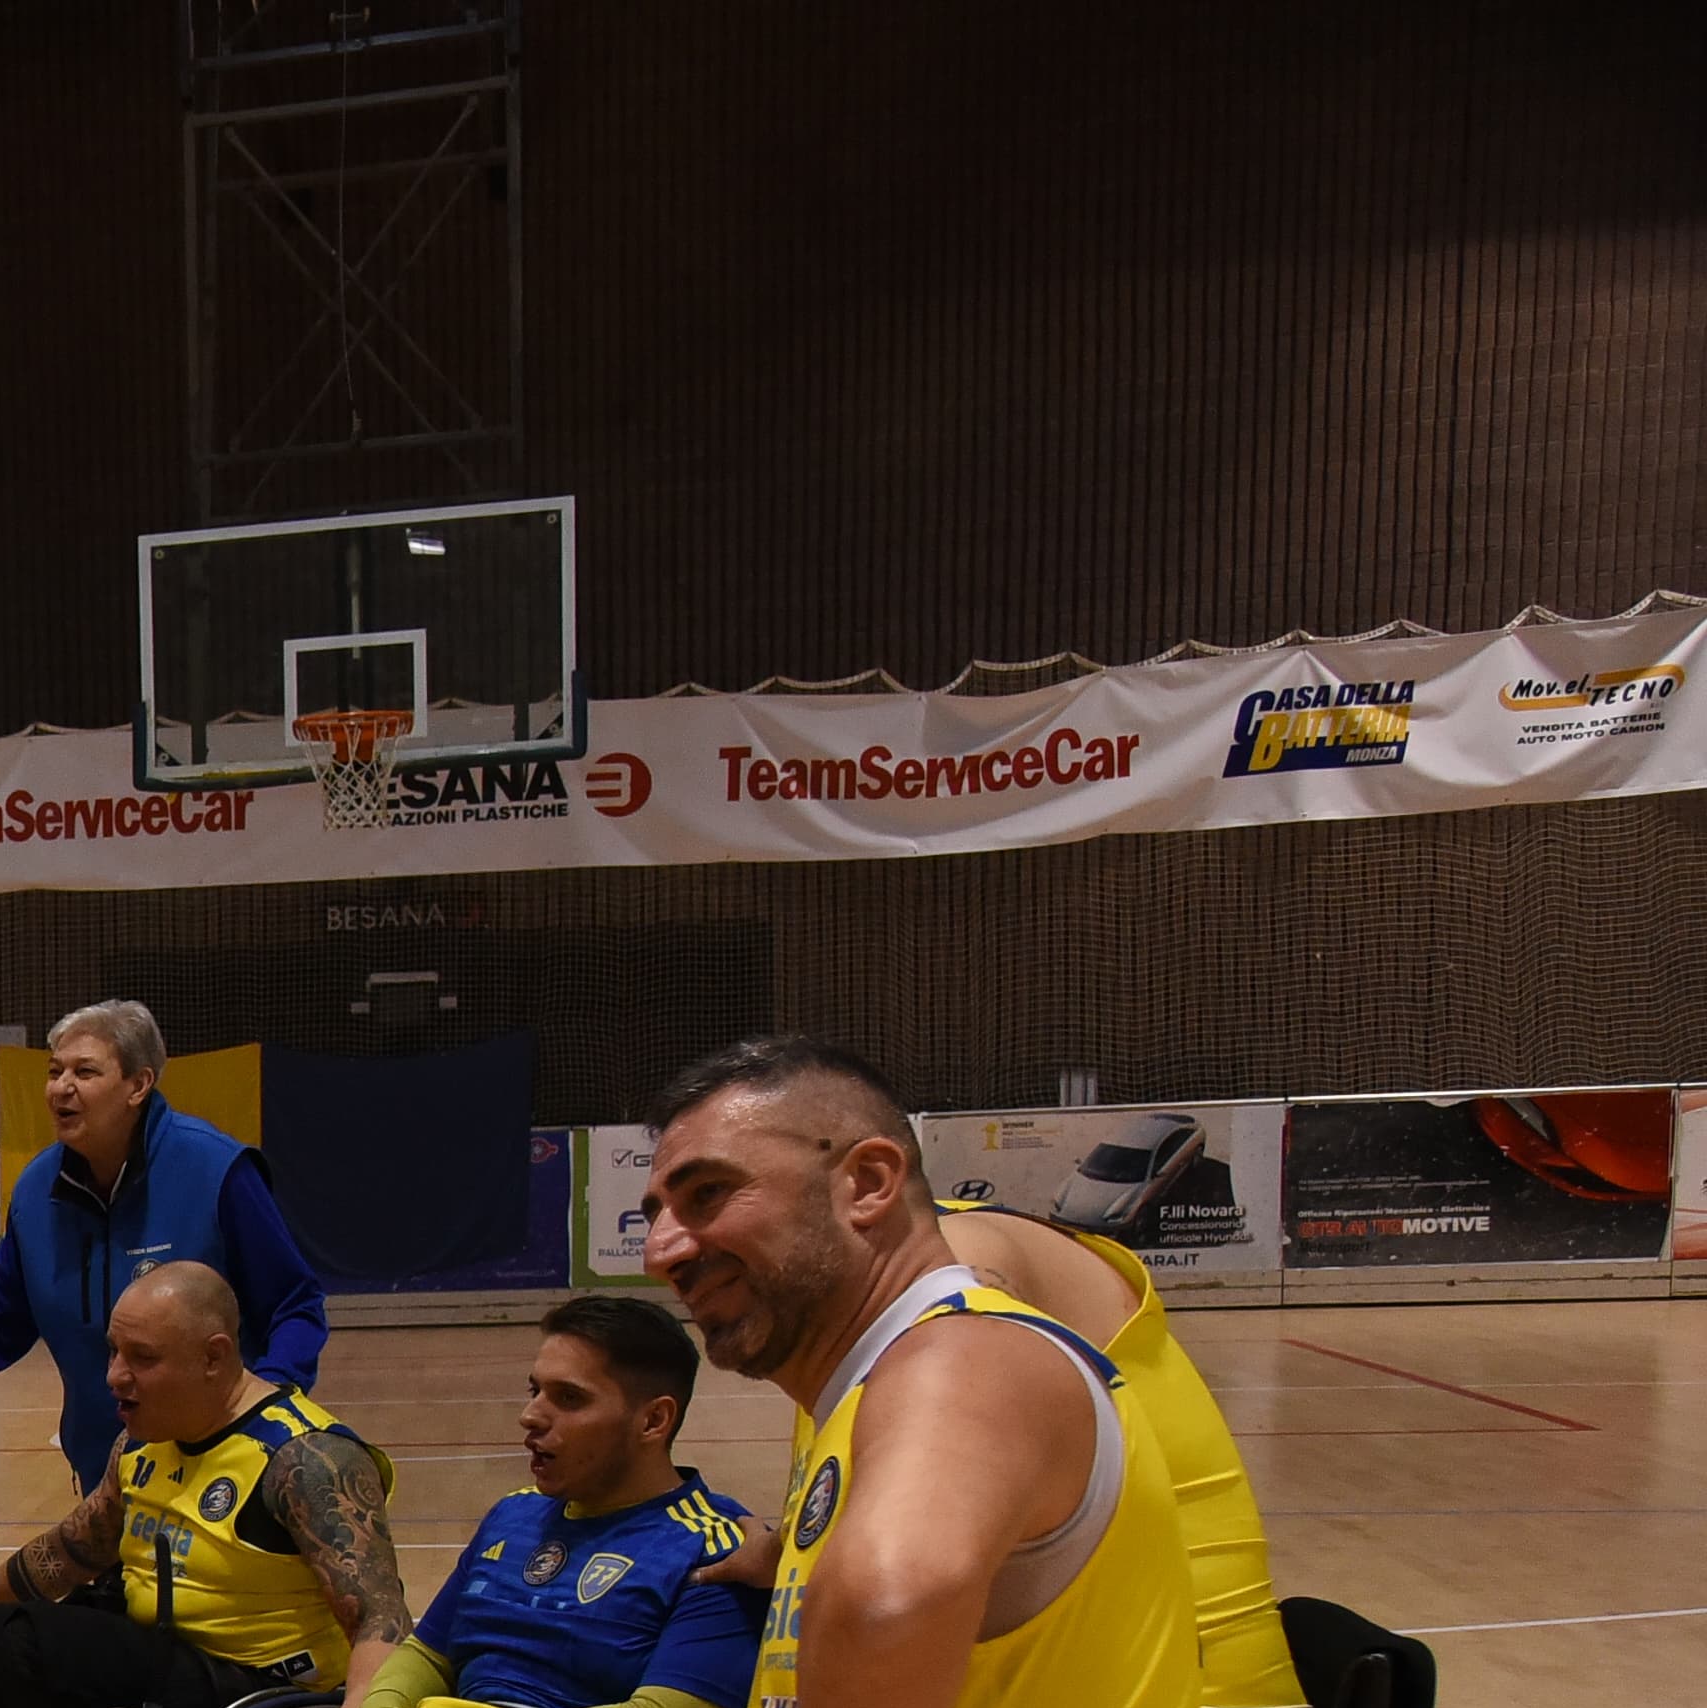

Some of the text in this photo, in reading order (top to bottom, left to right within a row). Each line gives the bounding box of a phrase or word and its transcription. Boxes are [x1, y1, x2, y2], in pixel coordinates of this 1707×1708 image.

[1590, 679, 1675, 707] TECNO
[1233, 680, 1415, 744] CASA DELLA
[1521, 712, 1661, 733] VENDITA BATTERIE
[1248, 705, 1412, 771] BATTERIA
[1517, 723, 1665, 745] AUTO MOTO CAMION
[1345, 746, 1398, 763] MONZA
[719, 729, 1140, 803] TeamServiceCar
[462, 803, 569, 824] PLASTICHE
[327, 904, 445, 931] BESANA
[1189, 1204, 1244, 1218] Novara
[1138, 1252, 1200, 1267] ARA.IT
[130, 1455, 156, 1489] 18
[585, 1564, 620, 1586] 77
